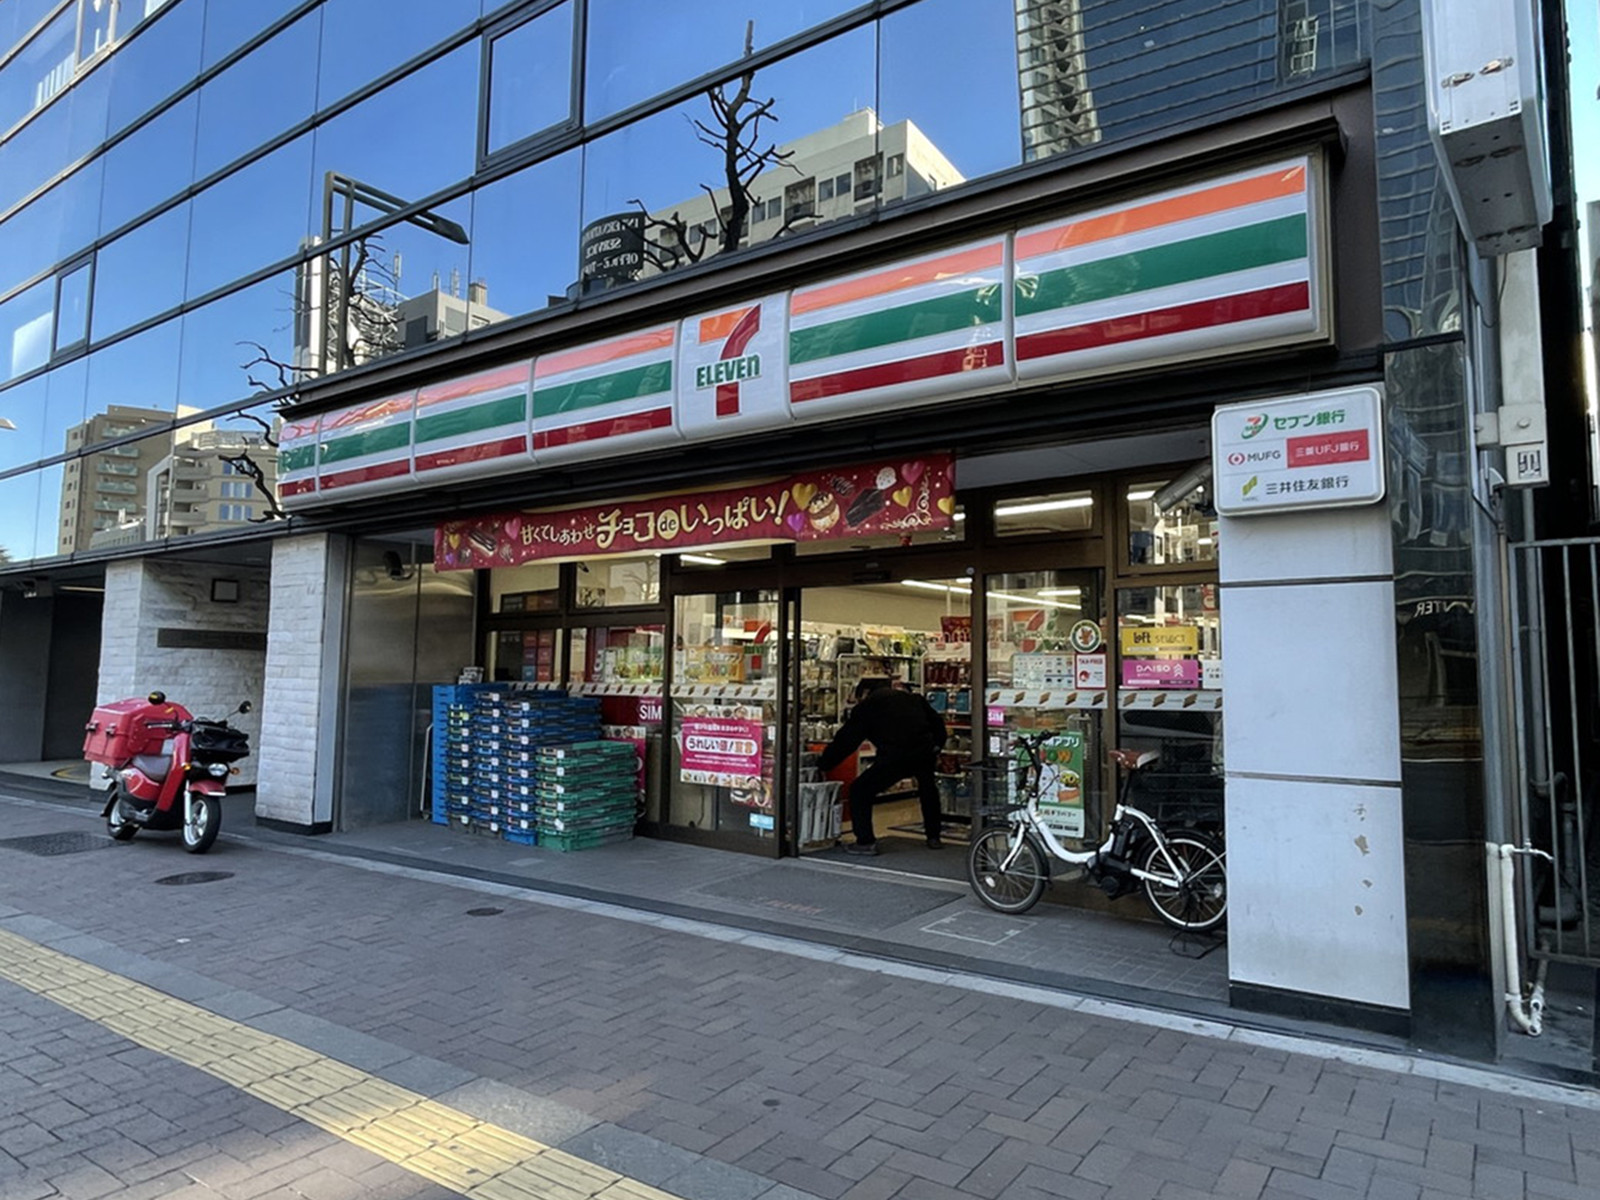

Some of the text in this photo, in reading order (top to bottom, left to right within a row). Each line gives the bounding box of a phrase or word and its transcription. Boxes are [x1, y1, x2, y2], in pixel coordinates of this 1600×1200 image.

[1273, 409, 1346, 430] セブン銀行
[1247, 450, 1281, 462] MUFG
[1266, 475, 1349, 495] 三井住友銀行
[1136, 664, 1171, 673] DAISO
[639, 704, 662, 720] SIM
